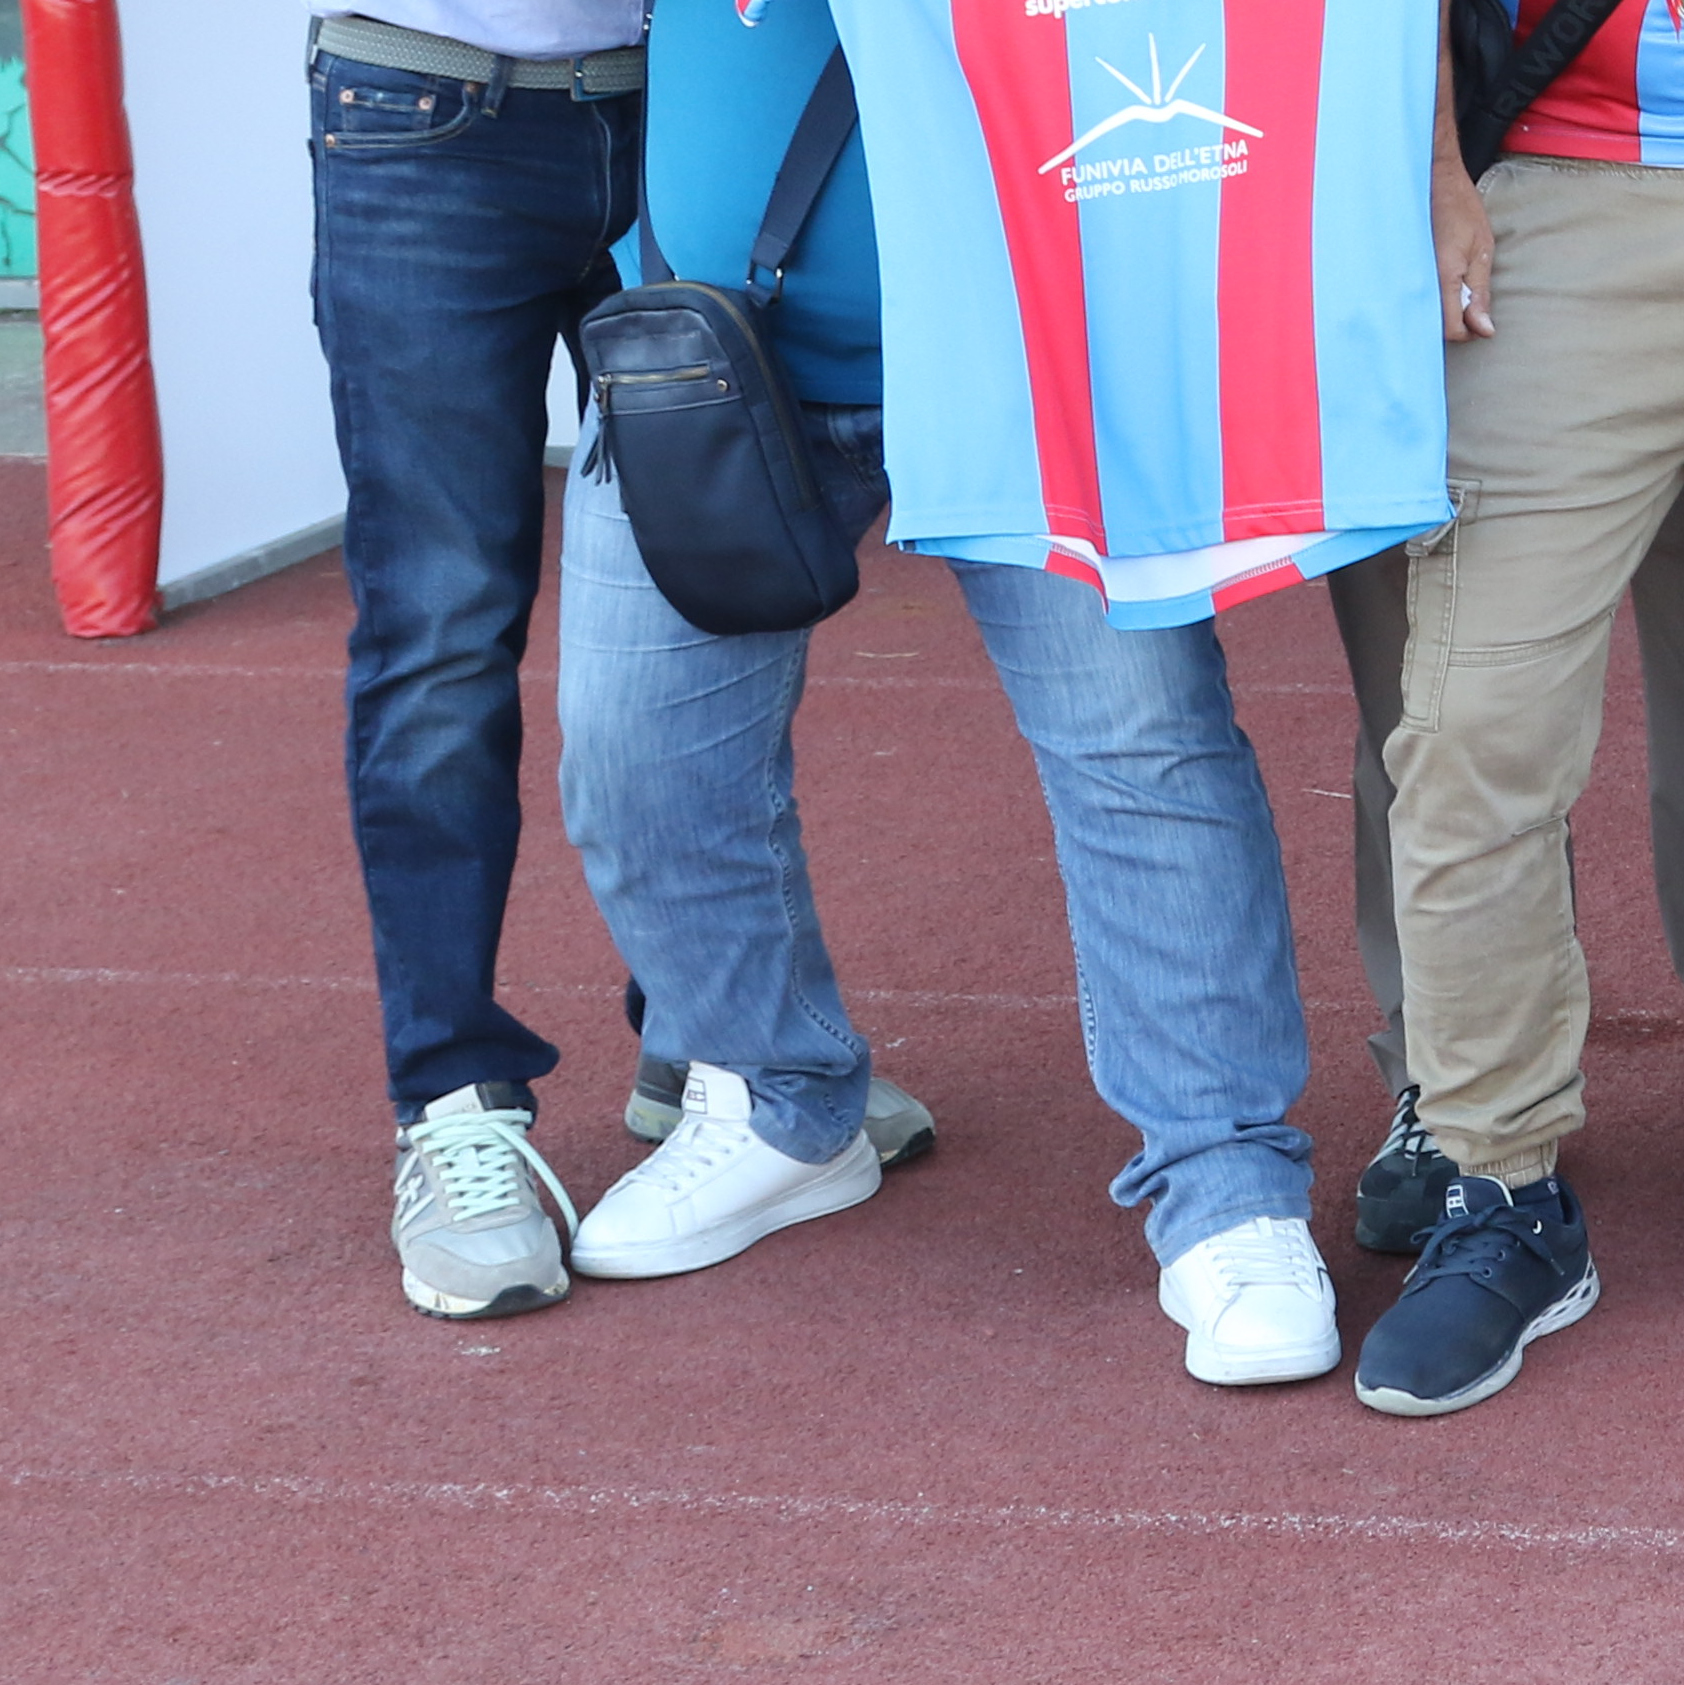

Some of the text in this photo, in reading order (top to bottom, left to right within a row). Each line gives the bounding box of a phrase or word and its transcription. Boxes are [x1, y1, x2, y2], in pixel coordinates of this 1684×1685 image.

[1060, 138, 1249, 186] FUNIVIA DELL'ETNA
[1063, 182, 1126, 203] GRUPPO
